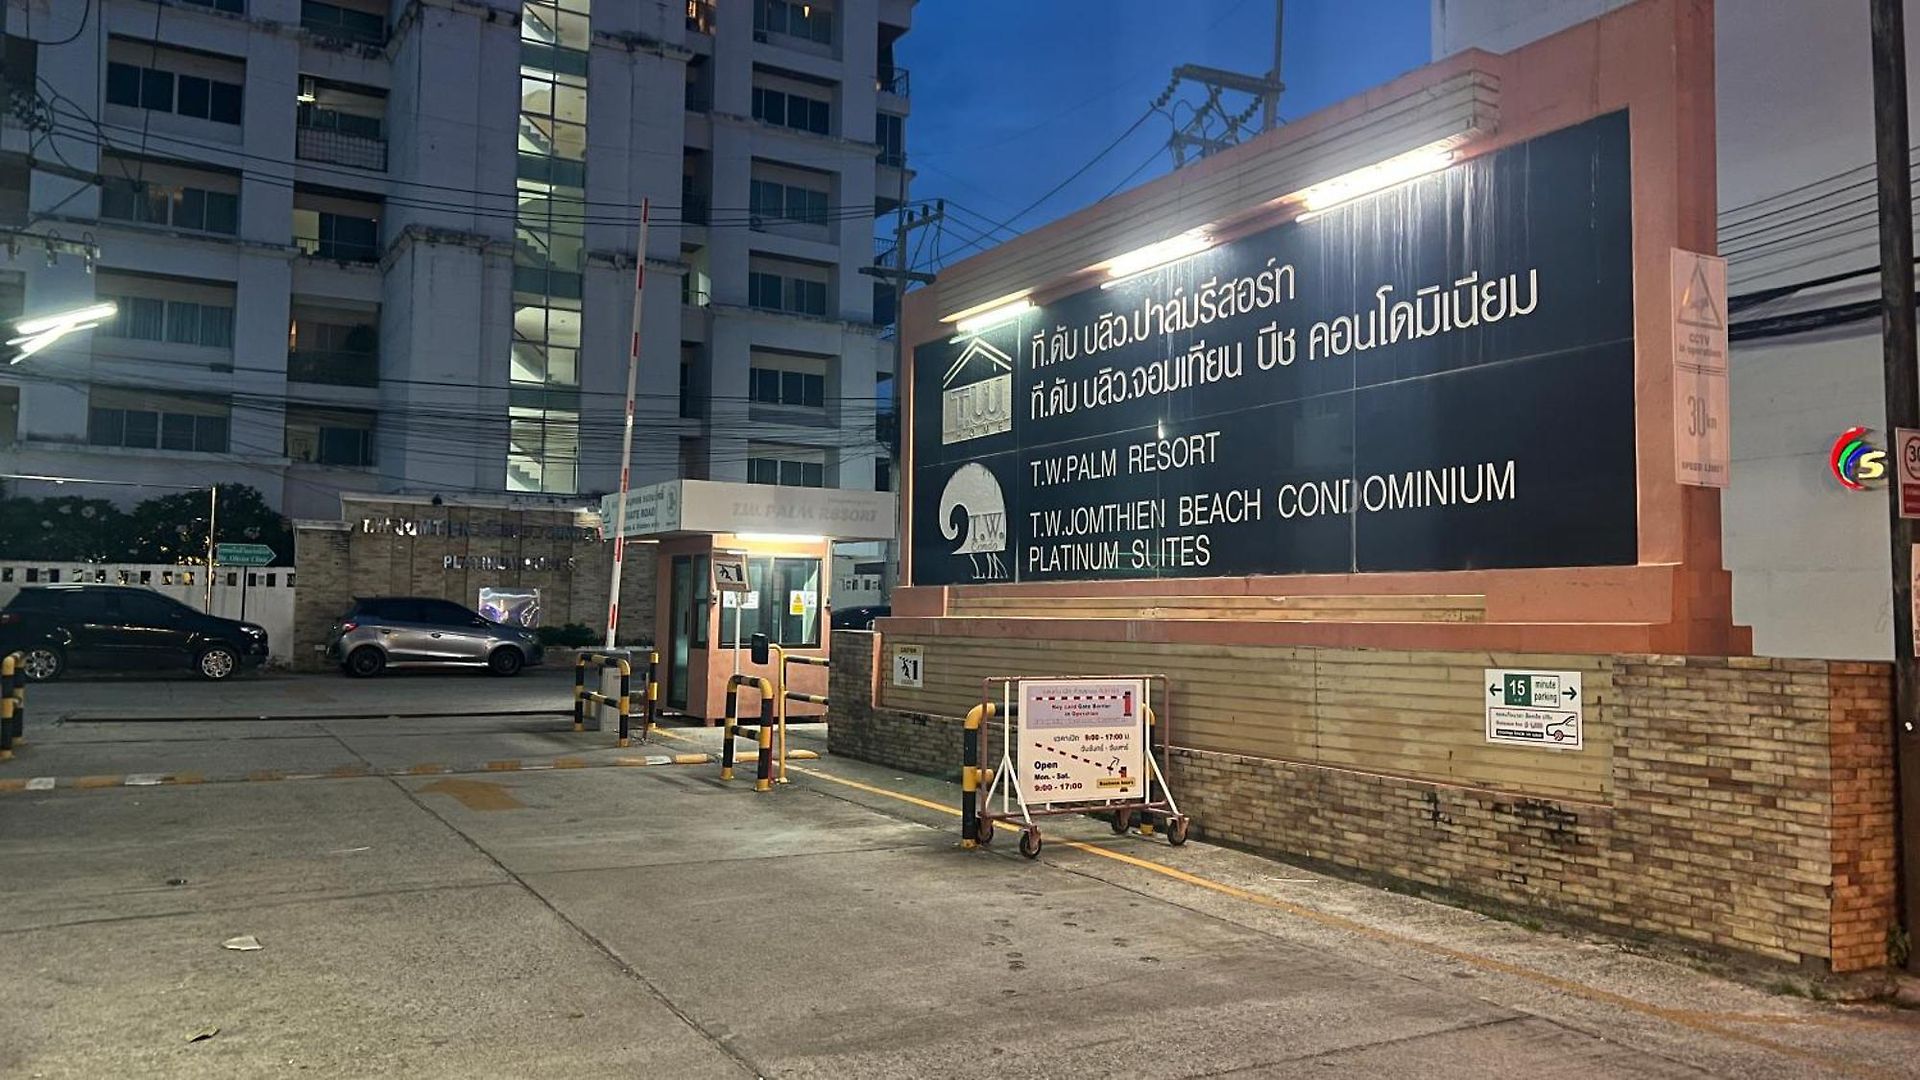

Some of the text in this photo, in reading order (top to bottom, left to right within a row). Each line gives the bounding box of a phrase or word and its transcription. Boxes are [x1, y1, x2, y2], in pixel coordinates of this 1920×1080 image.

[1257, 321, 1297, 370] บีช
[1310, 269, 1538, 361] คอนโดมิเนียม
[1689, 333, 1710, 347] CCTV
[1688, 396, 1706, 437] 30
[1030, 431, 1221, 487] T.W.PALM RESORT
[1030, 460, 1516, 538] T.W.JOMTHIEN BEACH CONDOMINIUM
[1029, 535, 1211, 572] PLATINUM SUITES
[1509, 680, 1526, 696] 15
[1535, 681, 1556, 690] minute
[1534, 692, 1557, 703] parking
[1034, 760, 1058, 771] Open
[1034, 784, 1053, 792] 9:00
[1060, 782, 1083, 791] 17:00
